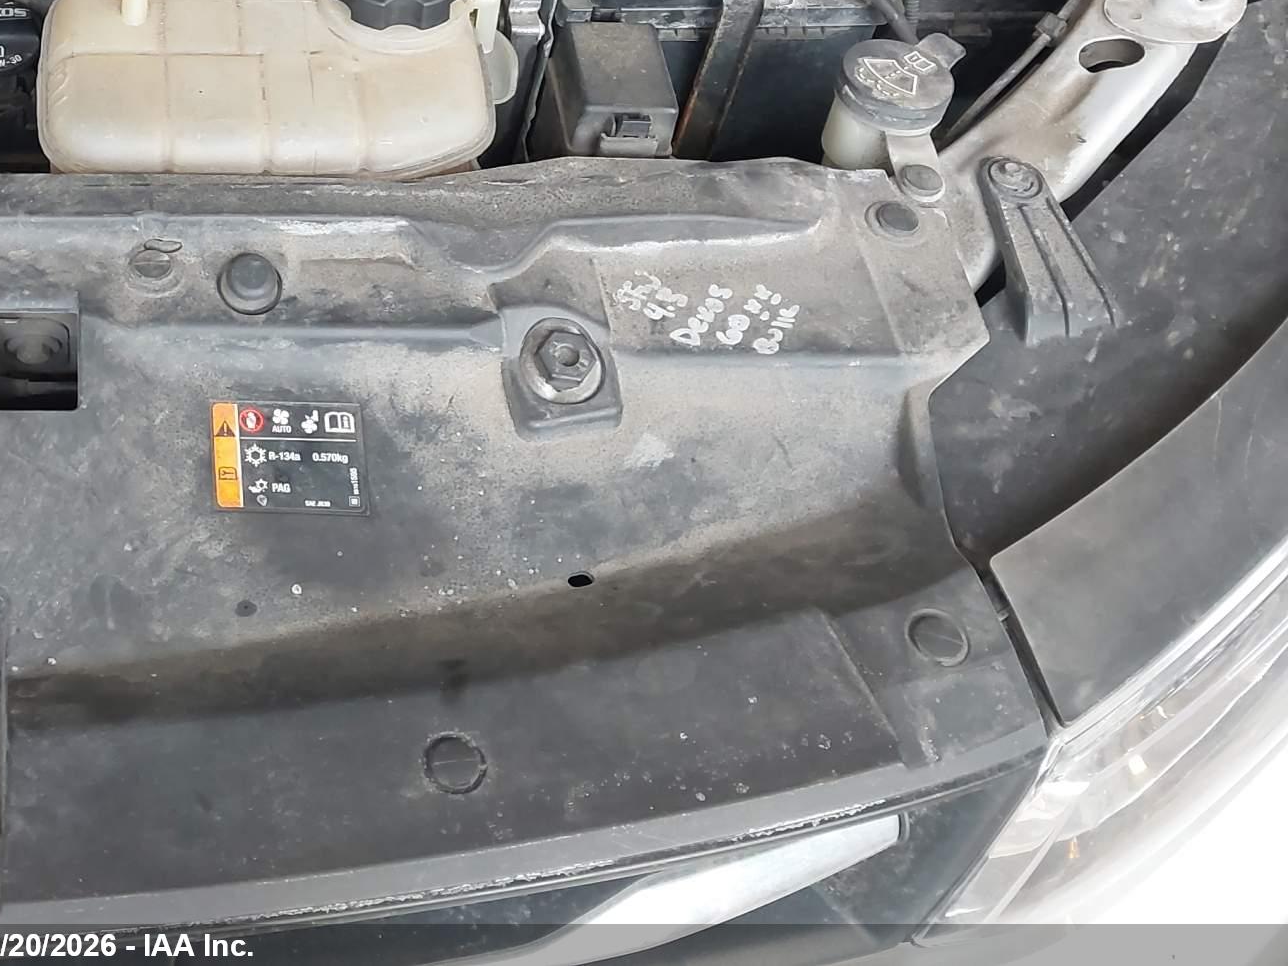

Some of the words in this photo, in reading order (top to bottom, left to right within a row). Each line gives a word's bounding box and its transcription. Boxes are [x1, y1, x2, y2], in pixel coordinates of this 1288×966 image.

[272, 425, 292, 433] AUTO
[268, 451, 301, 461] R-134a
[312, 452, 349, 464] 0.570kg
[272, 483, 291, 493] PAG
